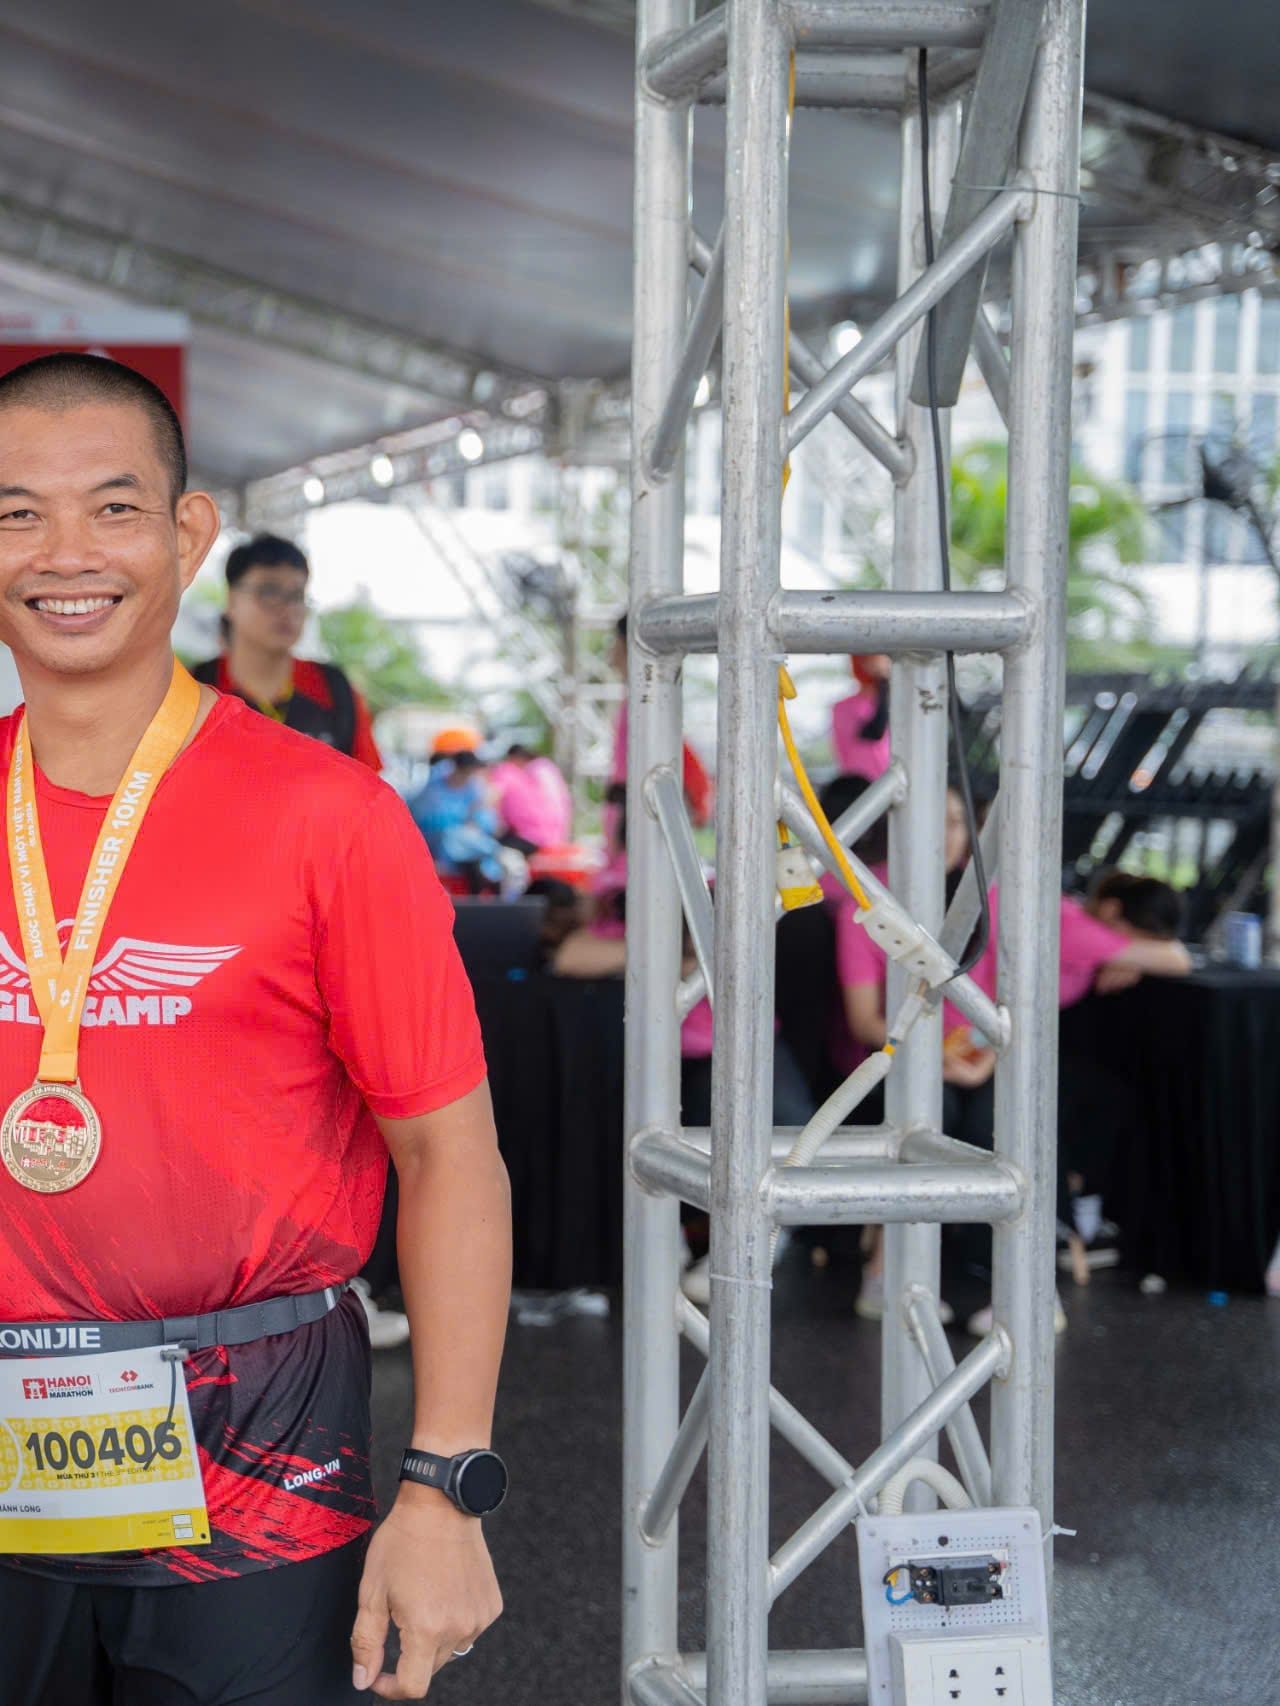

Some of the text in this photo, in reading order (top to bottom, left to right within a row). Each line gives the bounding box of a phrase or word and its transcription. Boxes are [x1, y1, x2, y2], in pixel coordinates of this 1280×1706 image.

[74, 770, 152, 951] FINISHER 10KM
[81, 995, 193, 1028] CAMP
[46, 1375, 92, 1389] HANOI
[49, 1389, 94, 1398] MARATHON
[25, 1420, 183, 1471] 100406
[283, 1458, 341, 1491] LONG.VN
[19, 1505, 41, 1513] LONG
